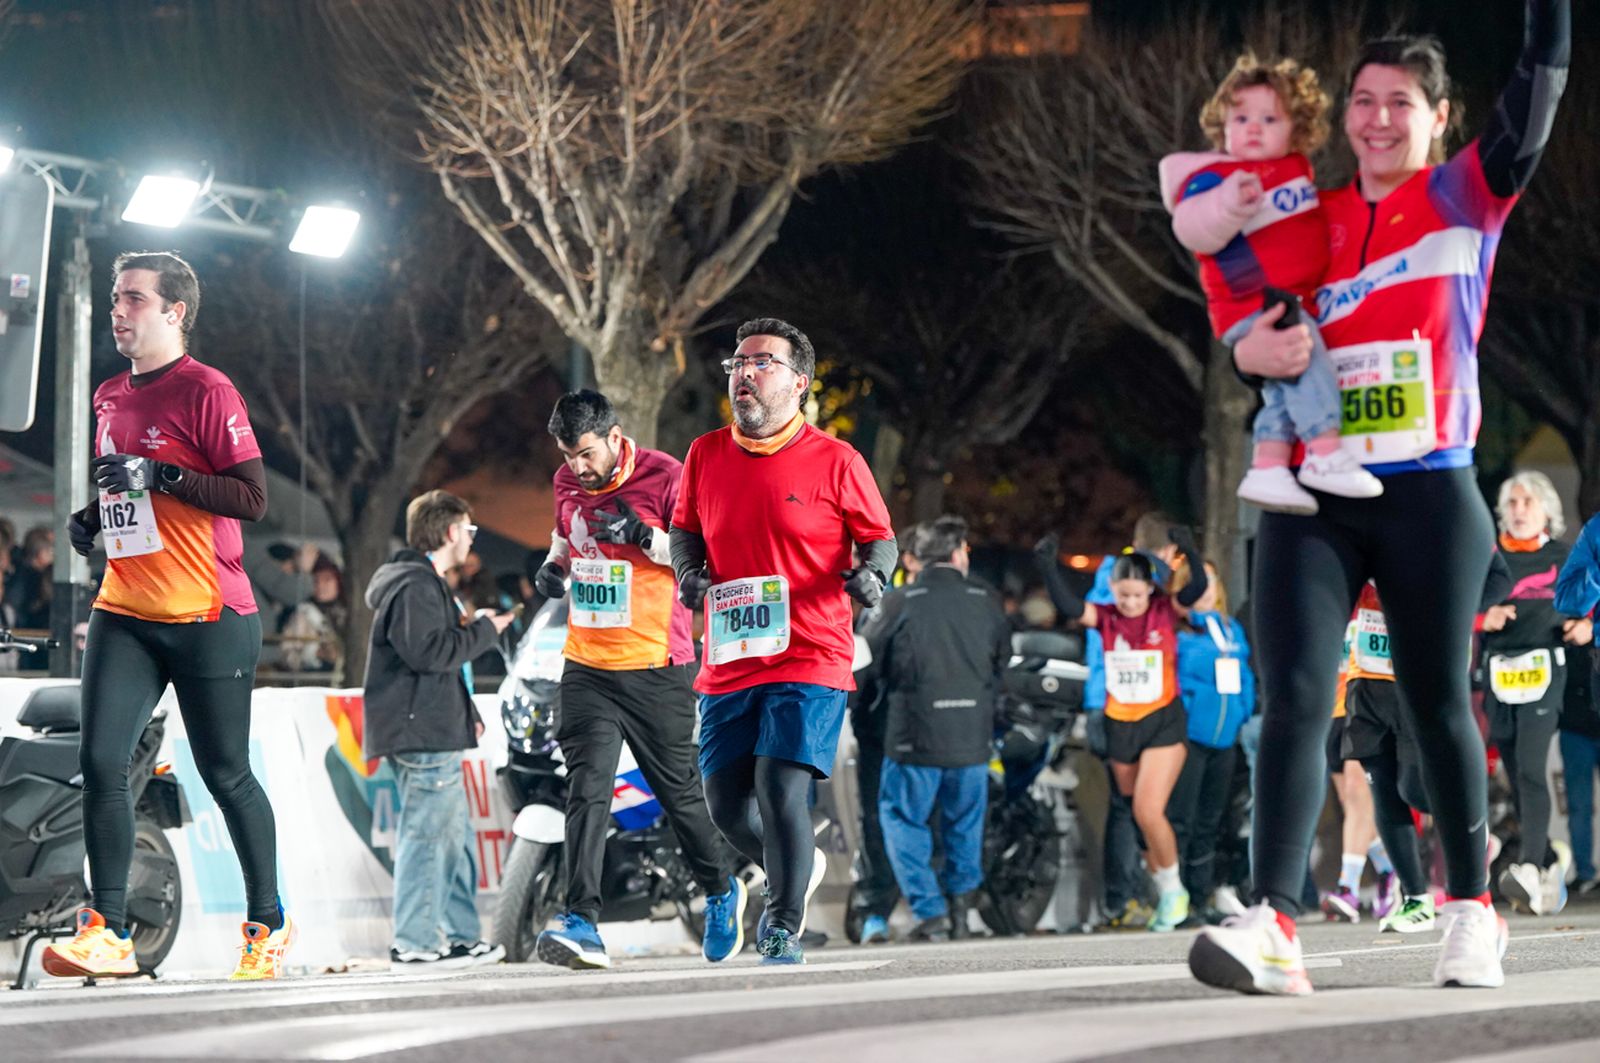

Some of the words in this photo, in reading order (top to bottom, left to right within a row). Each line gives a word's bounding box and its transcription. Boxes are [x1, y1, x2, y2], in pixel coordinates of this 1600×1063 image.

[1341, 384, 1406, 424] 566
[581, 542, 598, 560] 43
[577, 583, 617, 604] 9001
[722, 587, 743, 599] NOCHE
[744, 586, 754, 595] DE
[715, 600, 729, 612] SAN
[721, 604, 770, 634] 7840
[1369, 633, 1392, 653] 87
